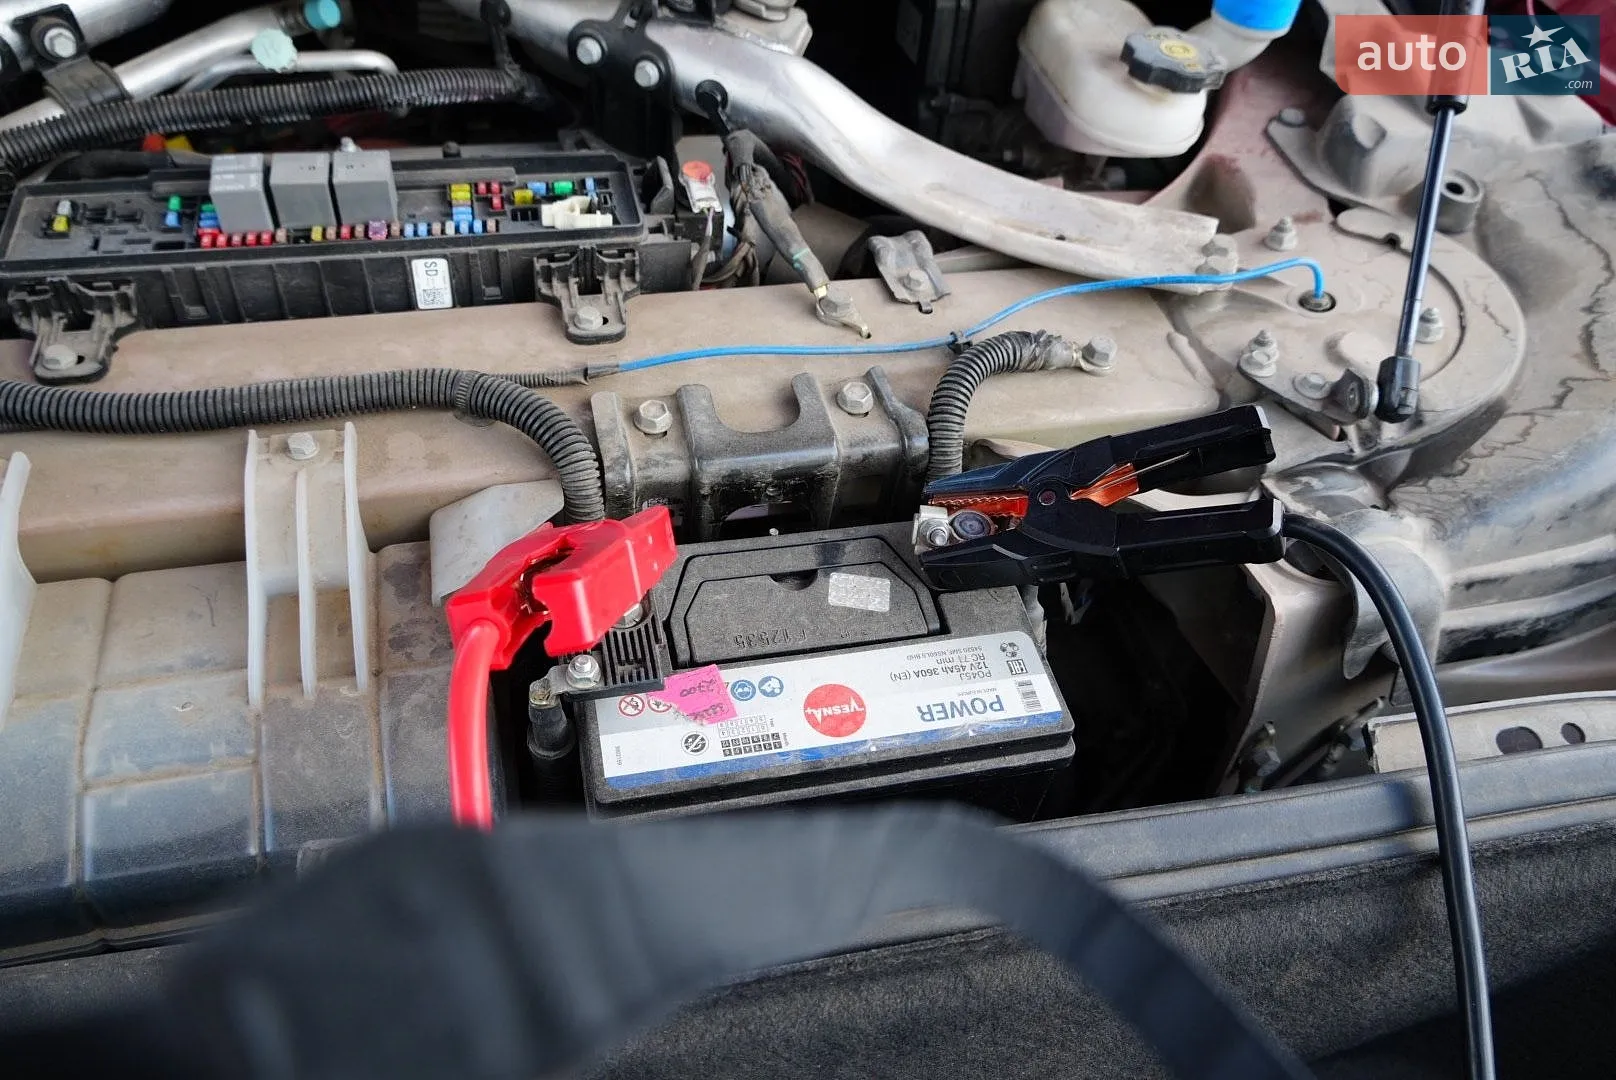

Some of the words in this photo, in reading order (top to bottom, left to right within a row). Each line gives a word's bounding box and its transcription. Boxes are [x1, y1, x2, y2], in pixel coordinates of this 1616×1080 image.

[424, 261, 439, 277] SD
[935, 656, 954, 665] min
[971, 652, 985, 661] RC
[941, 664, 966, 673] 45Ah
[970, 661, 988, 671] 12V
[889, 669, 911, 682] (EN)
[913, 667, 938, 678] 360A
[805, 696, 864, 724] VESNA
[916, 694, 1004, 722] POWER
